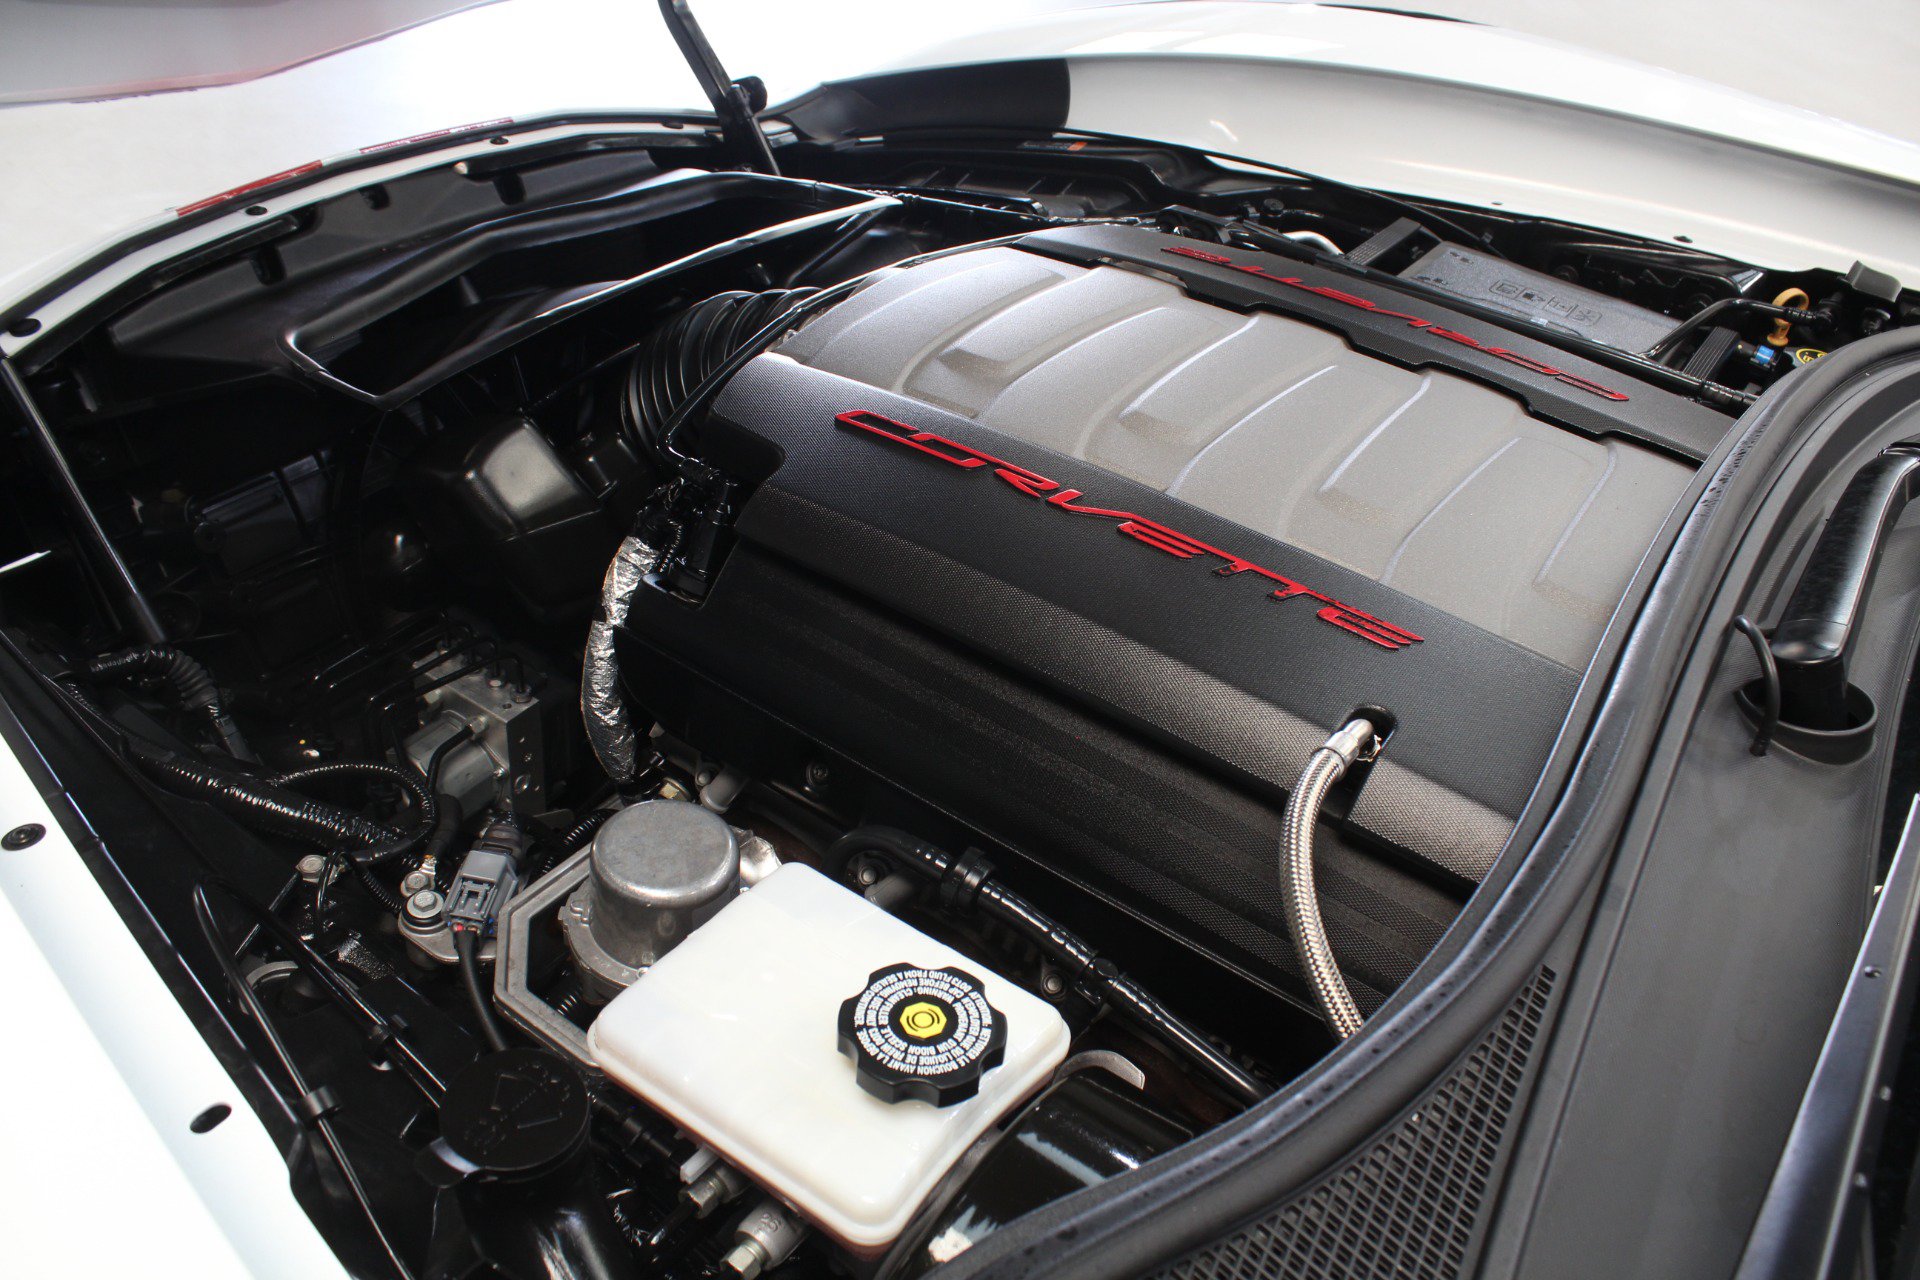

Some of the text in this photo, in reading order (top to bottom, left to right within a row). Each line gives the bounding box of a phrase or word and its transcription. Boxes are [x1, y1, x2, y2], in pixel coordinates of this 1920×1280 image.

[834, 409, 1425, 651] CORVETTE
[896, 972, 904, 980] A
[904, 970, 928, 978] FROM
[929, 971, 952, 981] FLUID
[870, 974, 898, 991] SEALED
[918, 978, 950, 990] BEFORE
[888, 988, 913, 1005] CLEAN
[948, 987, 965, 998] CAP
[869, 996, 884, 1010] USE
[960, 1035, 976, 1050] QUE
[880, 1043, 905, 1060] FREIN
[908, 1045, 936, 1056] BIDON
[951, 1046, 964, 1058] DU
[877, 1052, 890, 1064] LA
[905, 1054, 918, 1063] DE
[919, 1052, 951, 1065] LIQUIDE
[956, 1055, 970, 1066] LE
[887, 1059, 916, 1073] AVANT
[917, 1061, 958, 1075] BOUCHON
